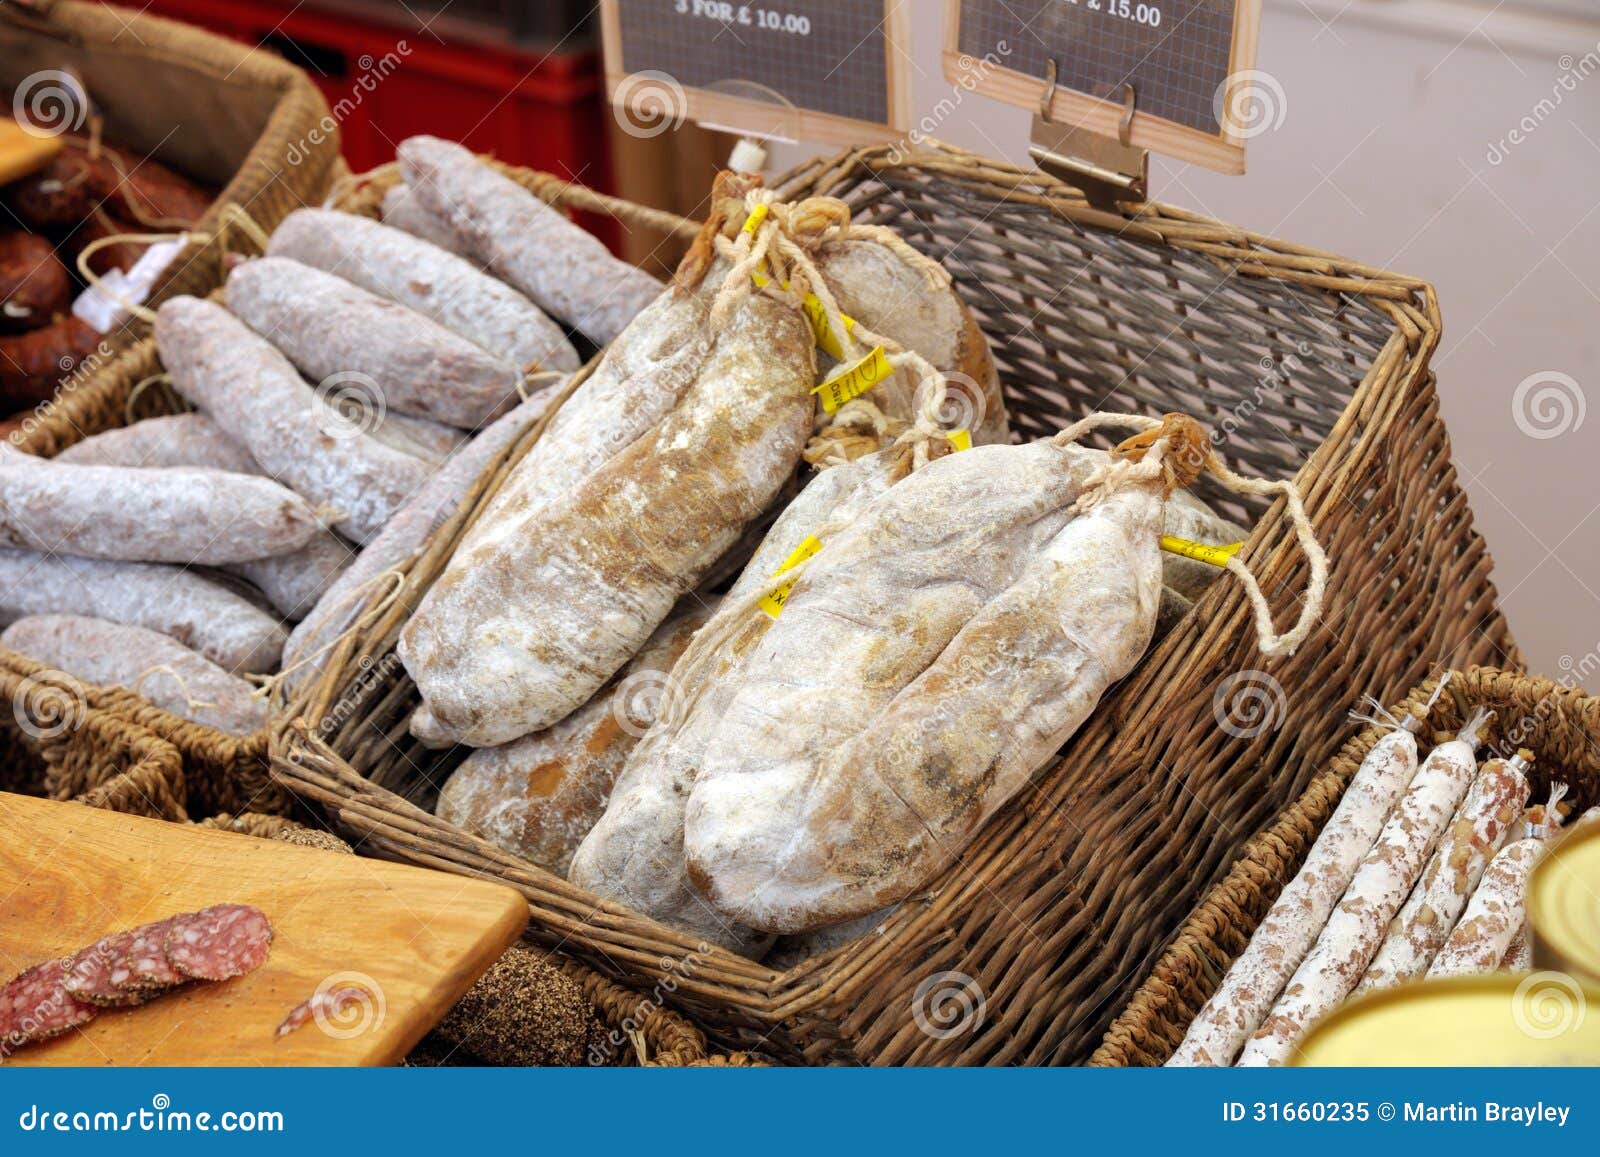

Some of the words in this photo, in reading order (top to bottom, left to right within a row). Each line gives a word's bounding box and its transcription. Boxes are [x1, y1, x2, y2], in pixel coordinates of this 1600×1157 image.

[692, 0, 733, 21] FOR
[737, 6, 752, 25] £
[757, 9, 811, 35] 10.00
[1108, 0, 1161, 27] 15.00
